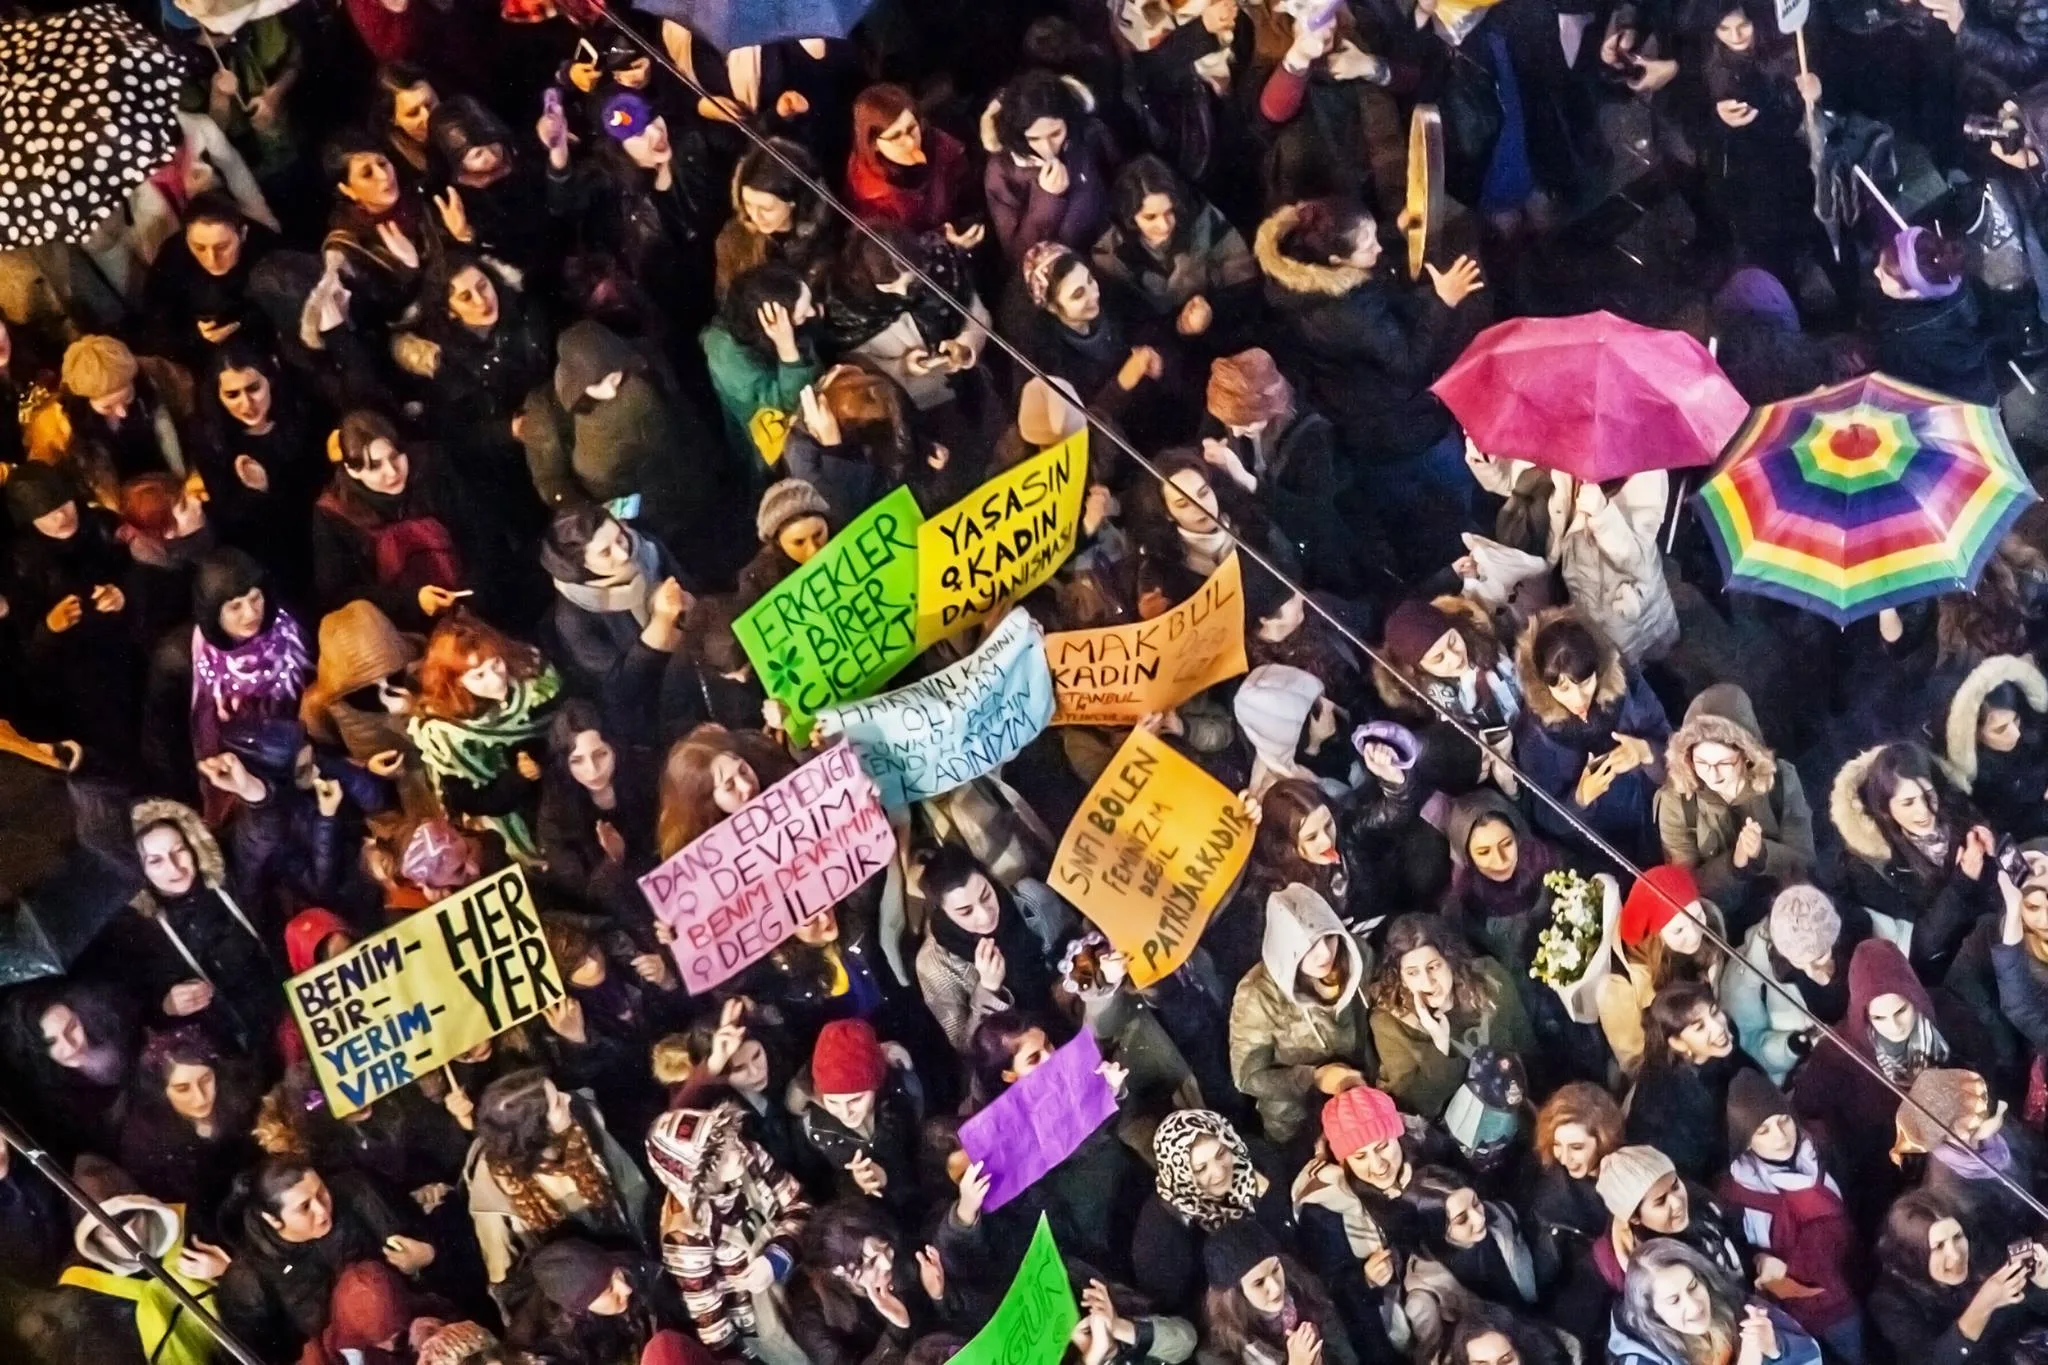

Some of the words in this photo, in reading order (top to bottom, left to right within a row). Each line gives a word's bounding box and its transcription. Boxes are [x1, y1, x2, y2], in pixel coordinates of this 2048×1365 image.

[939, 444, 1070, 556] YAŞASIN
[967, 502, 1057, 588] KADIN
[752, 512, 918, 653] ERKEKLER
[1051, 655, 1160, 690] KADIN
[1088, 747, 1160, 836] BÖLEN
[711, 788, 856, 901] DEVRİM
[436, 871, 539, 971] HER
[459, 936, 563, 1032] YER
